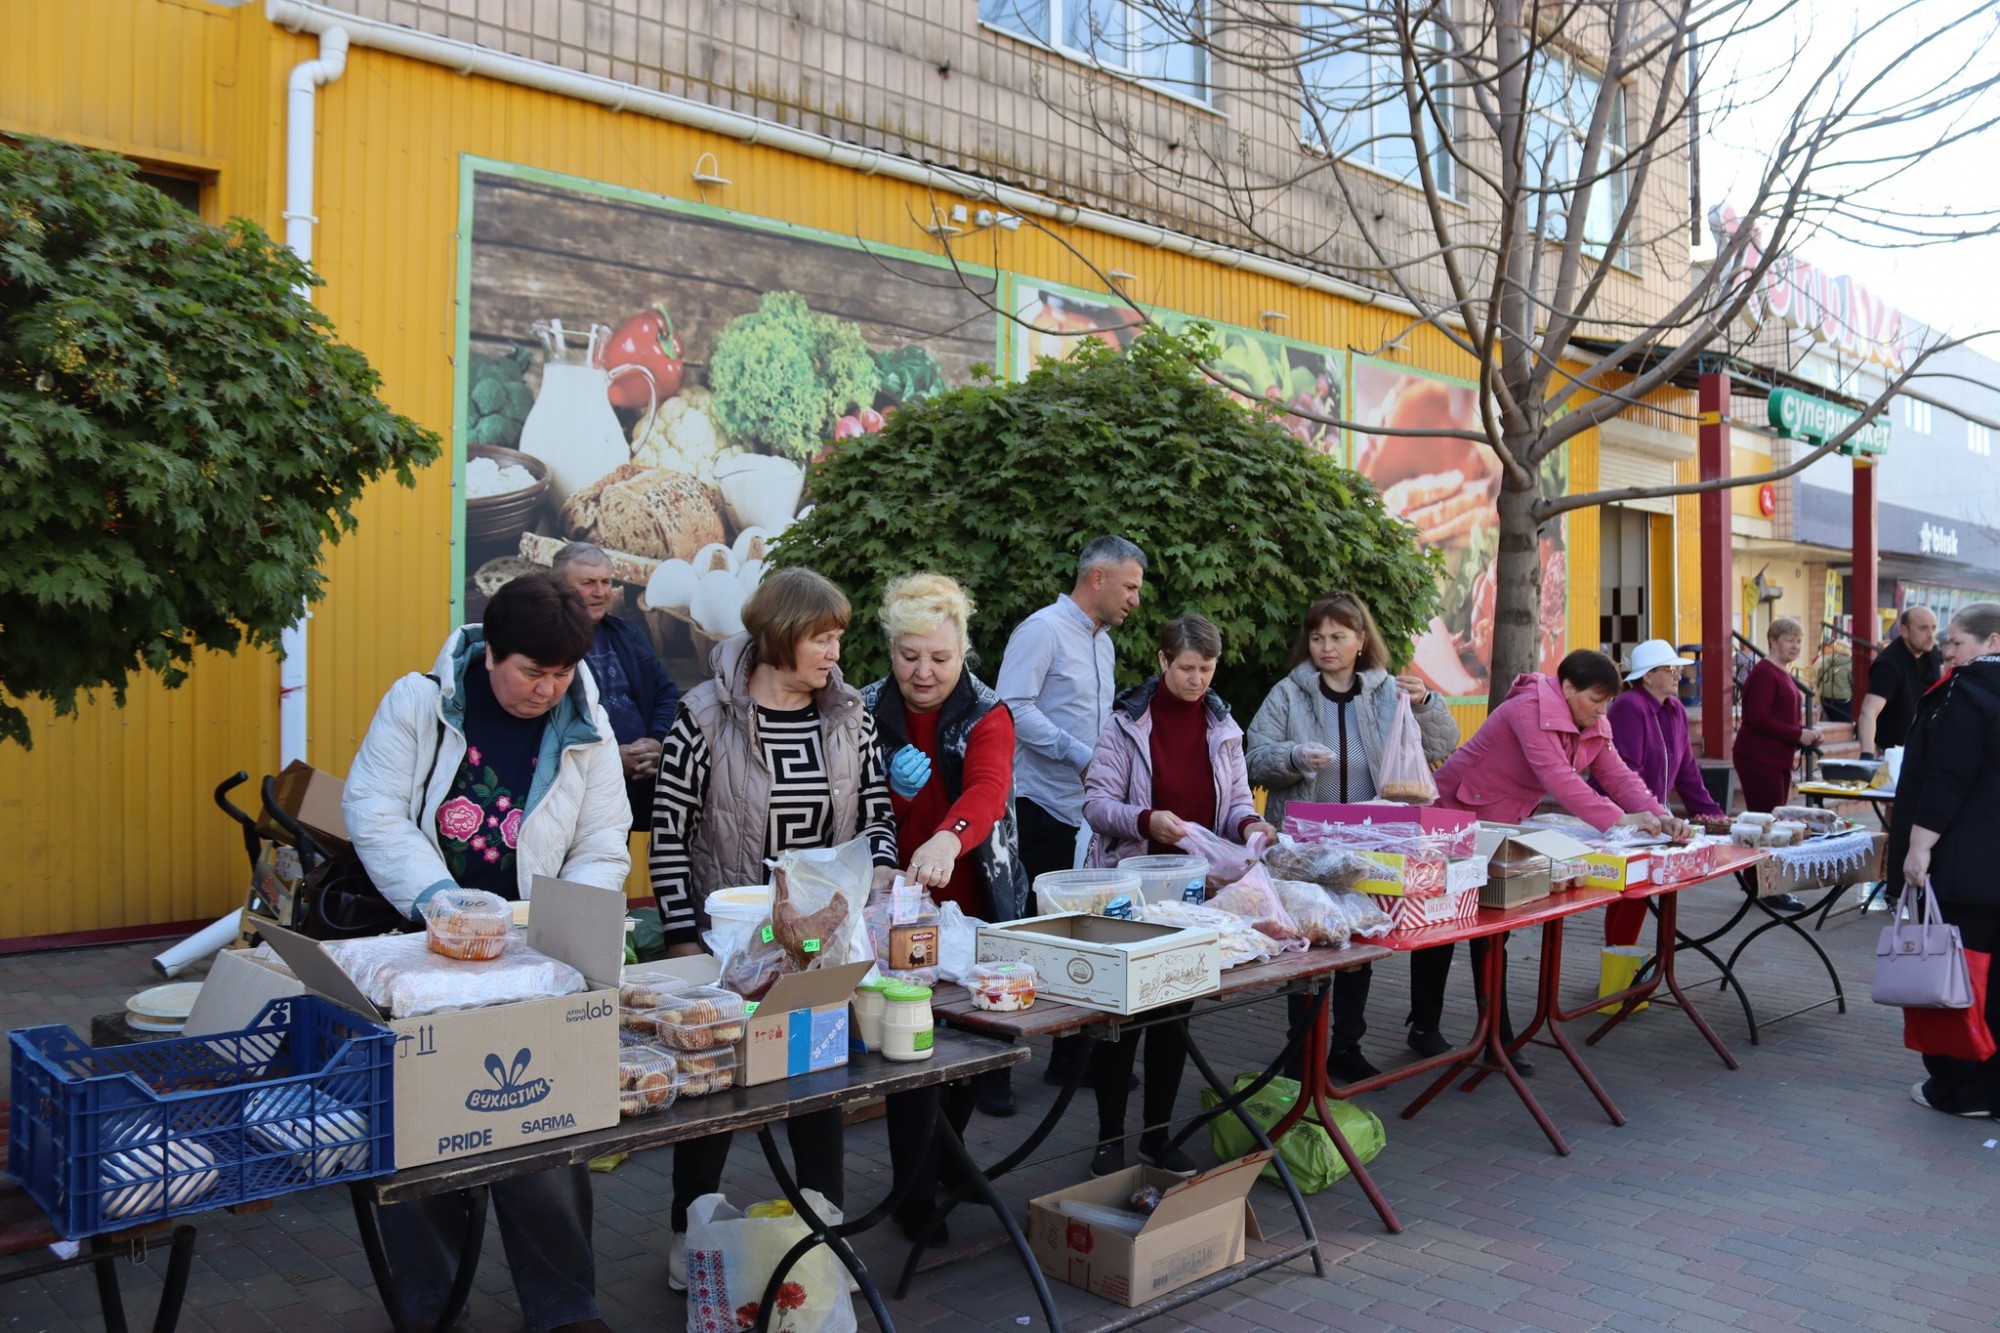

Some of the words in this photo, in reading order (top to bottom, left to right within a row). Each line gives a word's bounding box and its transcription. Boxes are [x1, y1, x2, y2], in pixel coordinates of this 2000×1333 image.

[586, 999, 613, 1020] lab
[470, 1080, 546, 1108] ВУХАСТИК
[521, 1113, 576, 1134] SARMA
[438, 1128, 493, 1155] PRIDE
